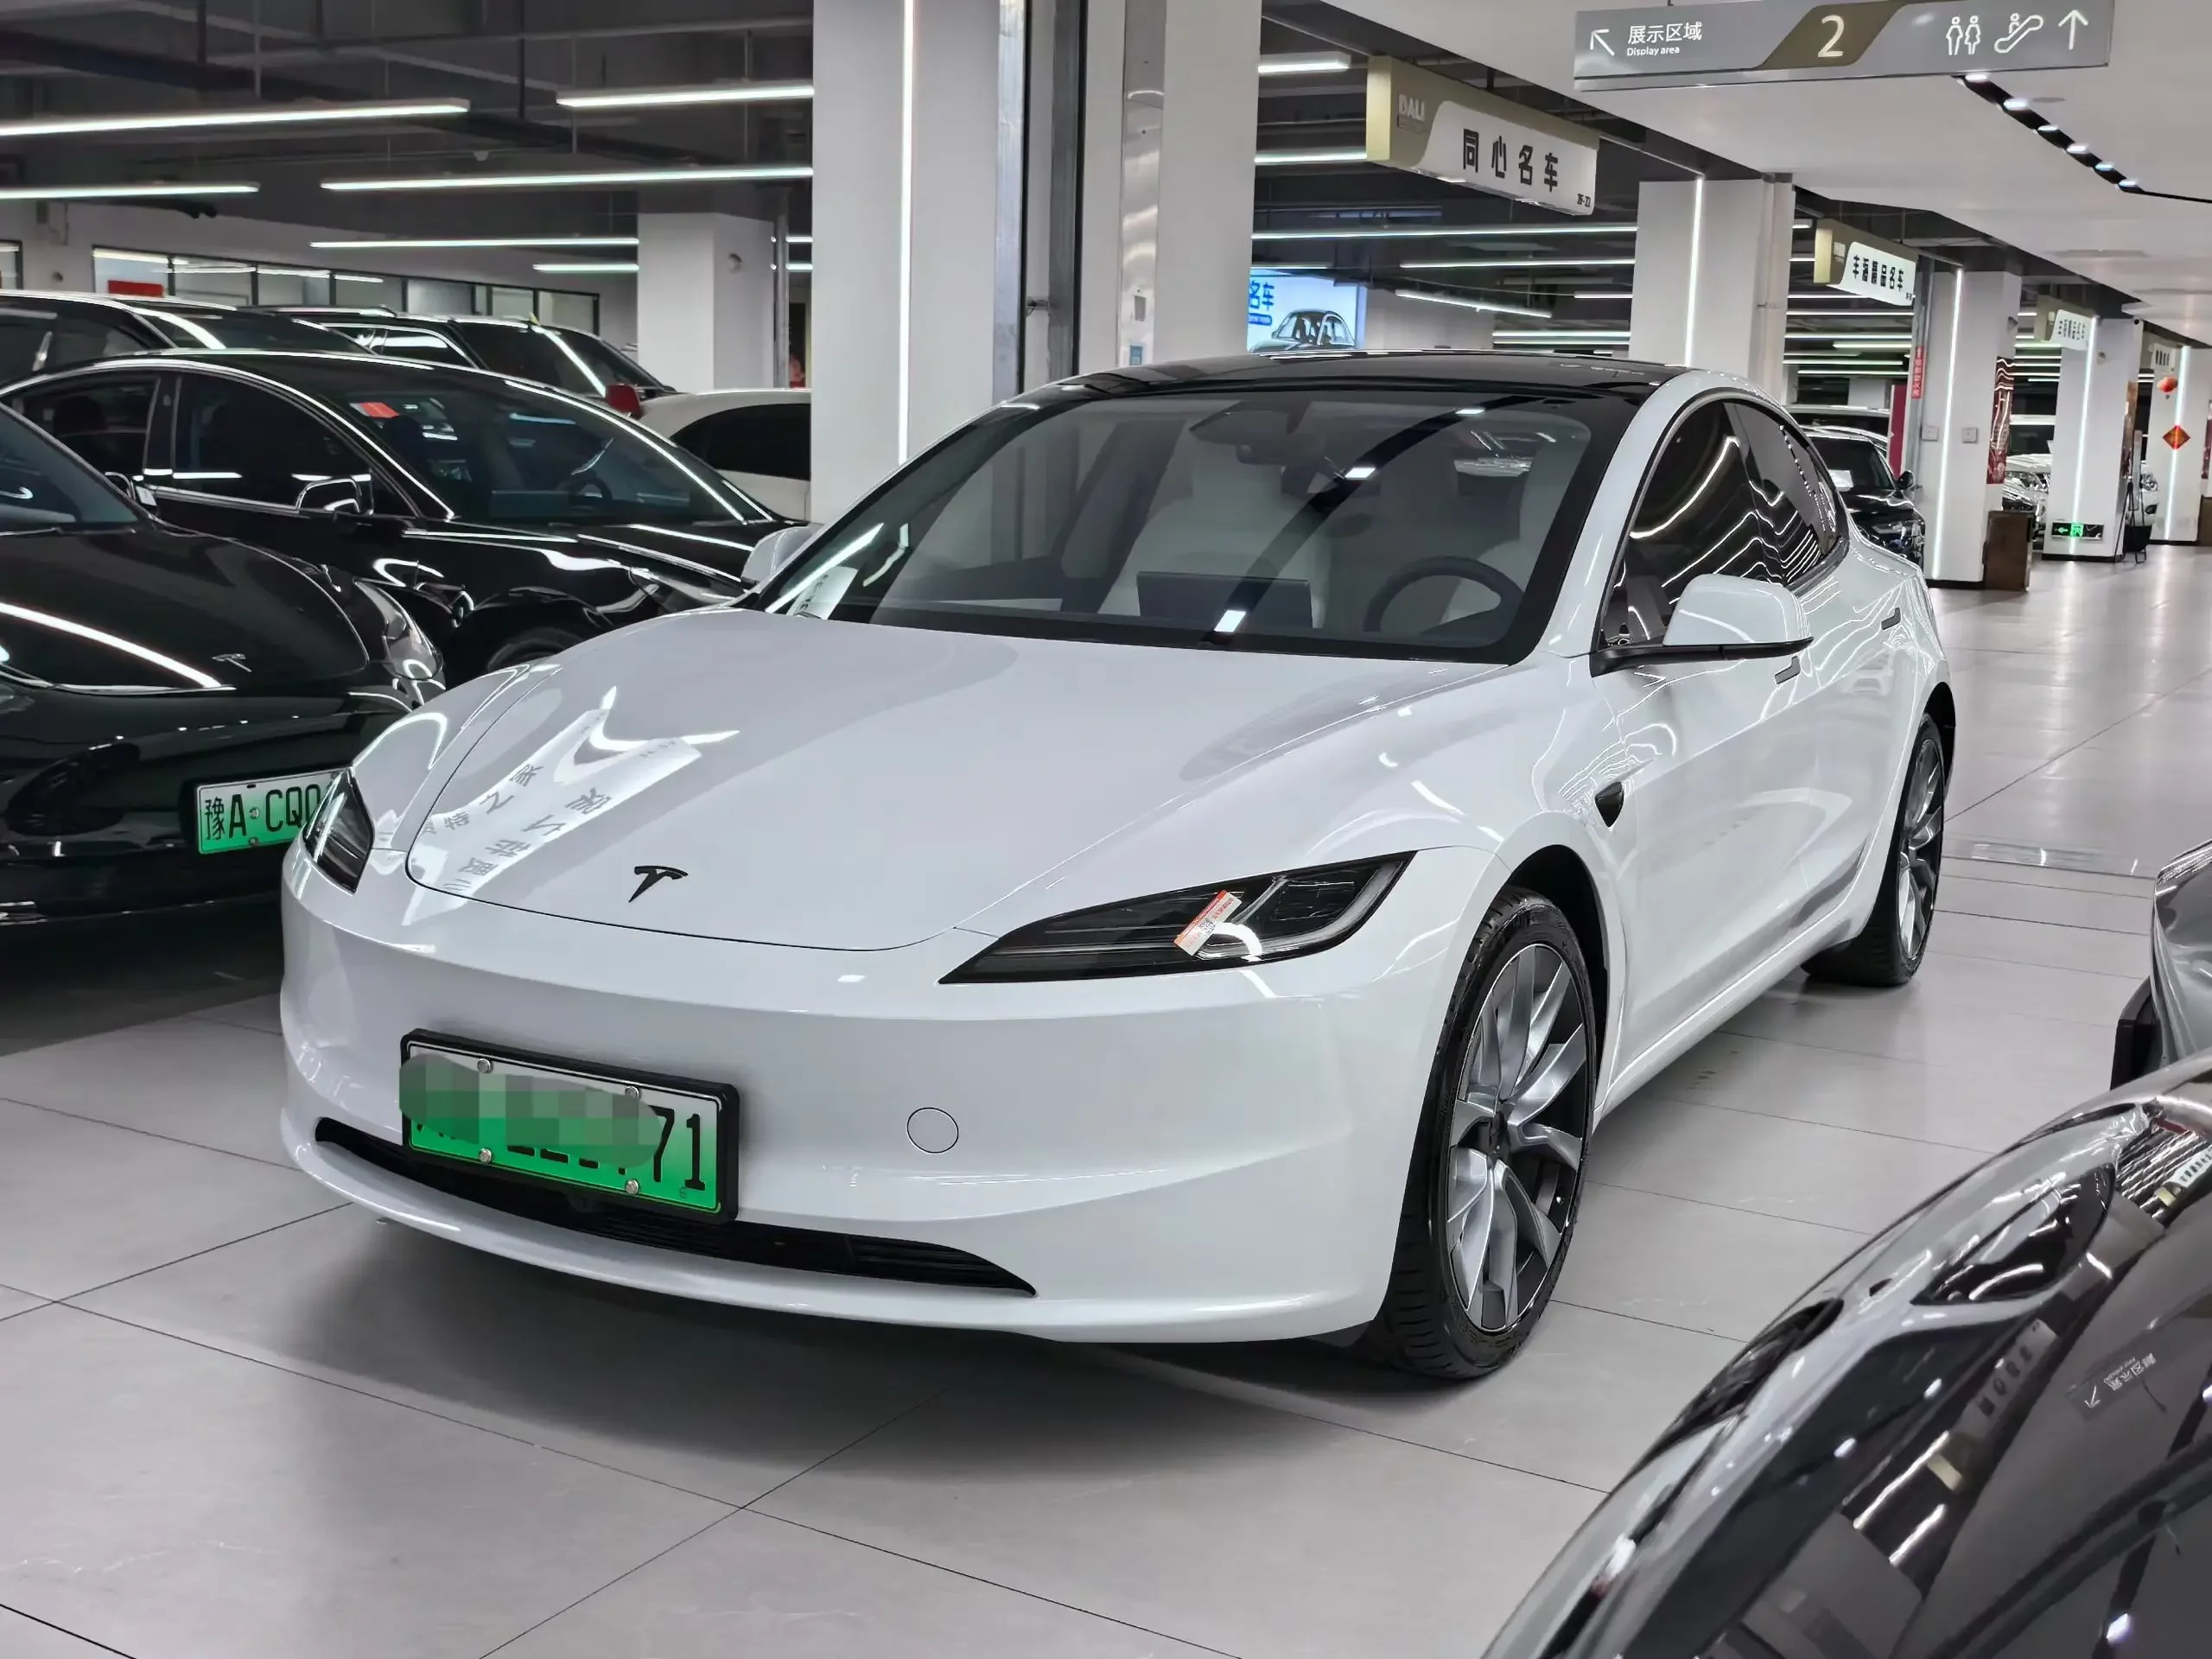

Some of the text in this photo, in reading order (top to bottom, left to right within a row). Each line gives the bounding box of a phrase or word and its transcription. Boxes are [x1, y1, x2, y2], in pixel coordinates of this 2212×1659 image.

[1626, 45, 1681, 56] Display area
[1627, 21, 1703, 46] 展示区域
[1817, 15, 1845, 58] 2
[1463, 127, 1559, 193] 同心名车
